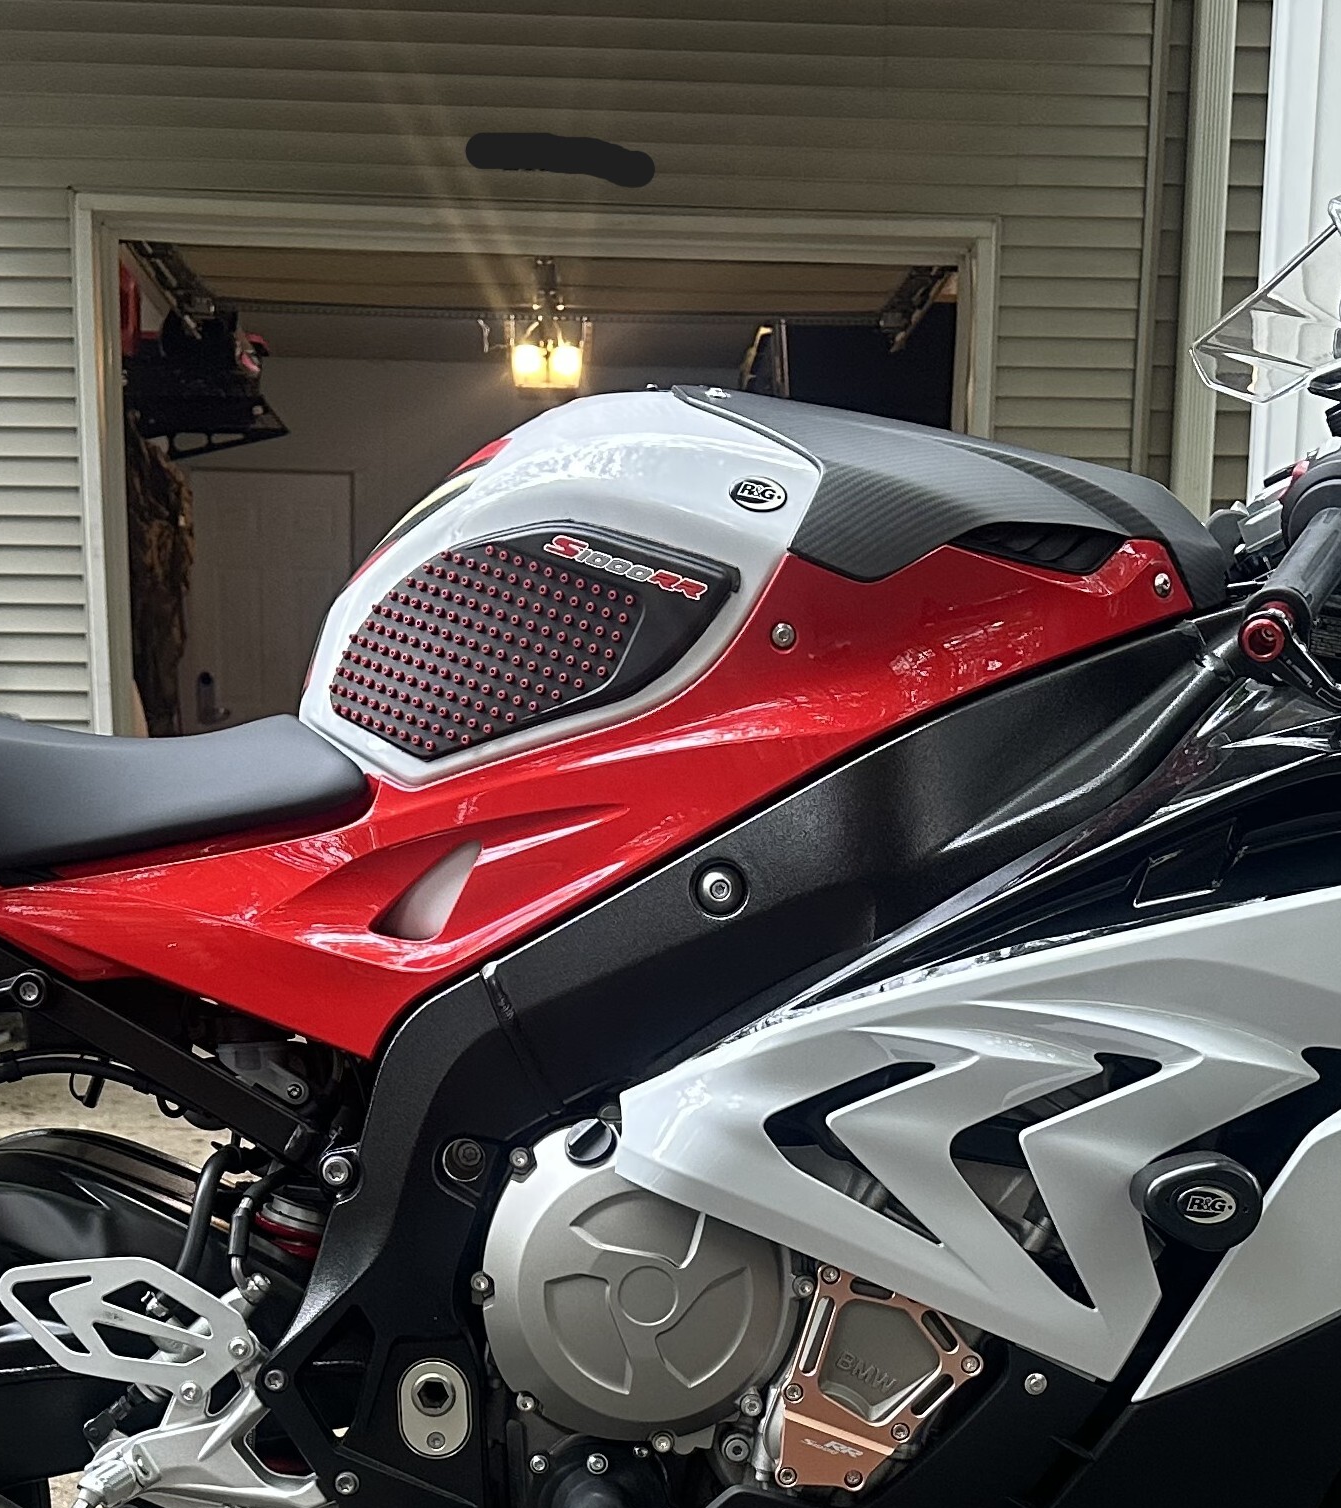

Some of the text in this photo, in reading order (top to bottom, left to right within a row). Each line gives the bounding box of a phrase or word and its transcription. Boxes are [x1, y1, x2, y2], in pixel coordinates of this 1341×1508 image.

[543, 534, 708, 601] S1000RR
[1186, 1195, 1228, 1214] R&G
[835, 1350, 897, 1392] BMW
